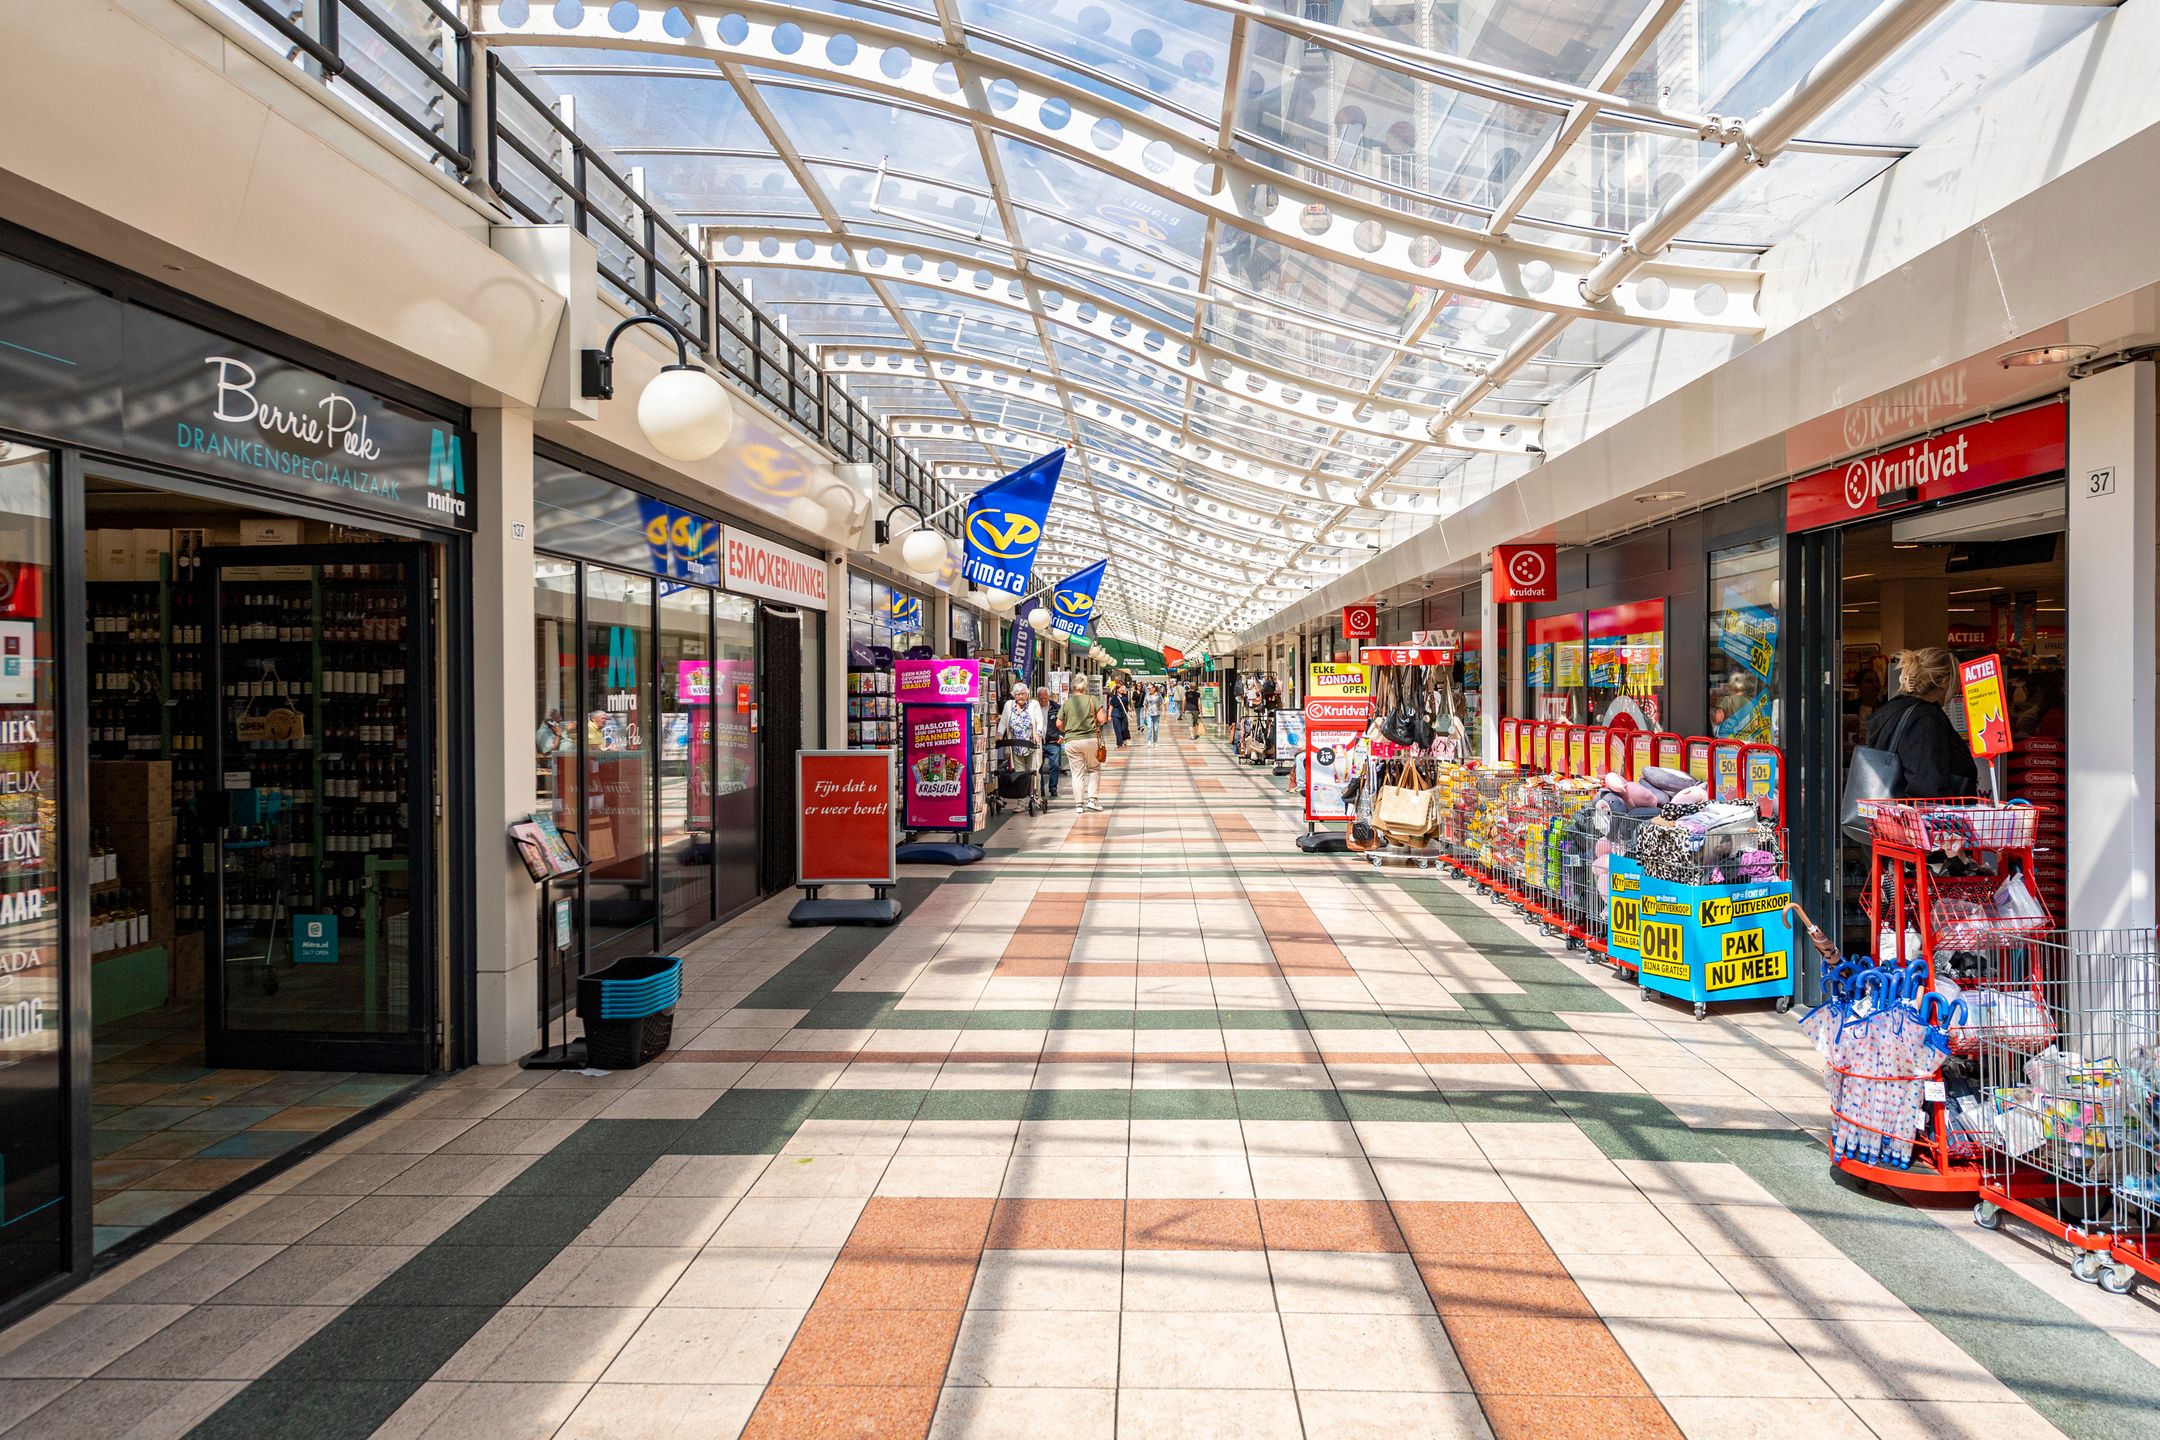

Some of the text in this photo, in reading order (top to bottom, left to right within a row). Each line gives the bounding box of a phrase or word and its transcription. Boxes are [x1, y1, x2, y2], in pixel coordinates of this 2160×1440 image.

[205, 356, 380, 461] Berrie Peek
[177, 422, 400, 501] DRANKENSPECIAALZAAK
[1871, 434, 1968, 497] Kruidvat
[2090, 472, 2109, 493] 37
[427, 491, 465, 516] mitra
[513, 523, 524, 537] 137
[729, 540, 826, 600] ESMOKERWINKEL
[1509, 588, 1545, 596] Kruidvat
[1948, 632, 1984, 643] ACTIE!
[1752, 646, 1766, 673] 50%
[1320, 674, 1361, 685] ZONDAG
[1965, 660, 1995, 682] ACTIE!
[607, 690, 637, 711] mitra
[1323, 705, 1370, 716] Kruidvat
[914, 720, 960, 731] KRASLOTEN.
[915, 732, 960, 742] SPANNEND
[934, 738, 960, 746] KRIJGEN
[1752, 766, 1767, 779] 50%
[815, 779, 877, 798] Fijn dat u
[918, 783, 958, 793] KRASLOTEN
[805, 801, 887, 815] er weer bent!
[1612, 874, 1624, 889] Krrr
[1642, 896, 1656, 912] Krrr
[1656, 903, 1689, 914] UITVERKOOP
[1702, 895, 1788, 924] Krrr UITVERKOOP
[1615, 934, 1628, 944] BIJNA
[1643, 924, 1678, 960] OH!
[1726, 933, 1758, 956] PAK
[1643, 958, 1660, 971] BIJNA
[1712, 956, 1779, 986] NU MEE!
